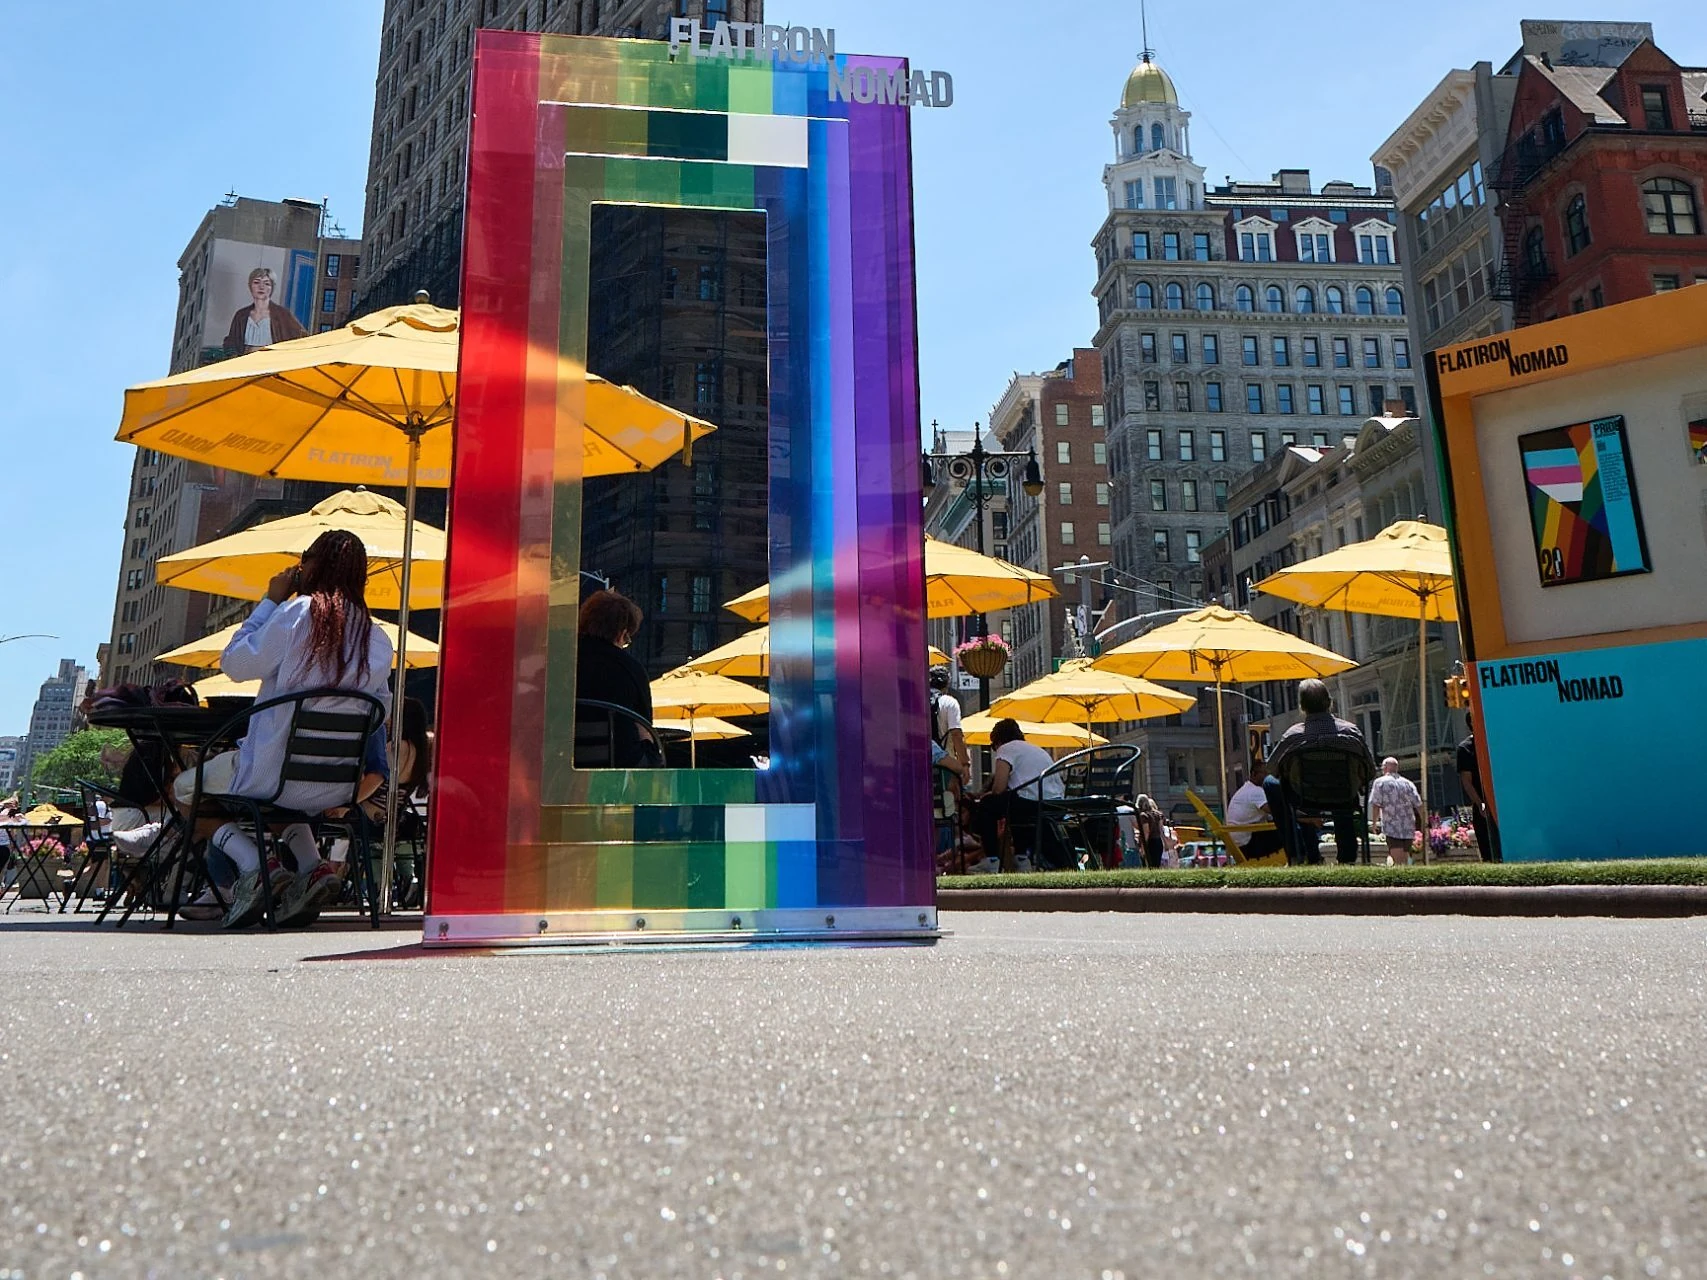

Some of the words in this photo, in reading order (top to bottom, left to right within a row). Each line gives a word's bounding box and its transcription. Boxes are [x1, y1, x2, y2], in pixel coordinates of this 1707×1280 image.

[668, 17, 836, 65] FLATIRON
[828, 64, 954, 108] NOMAD
[1438, 339, 1511, 374] FLATIRON
[1509, 345, 1569, 376] NOMAD
[307, 447, 393, 468] FLATIRON
[382, 465, 448, 480] NOAD
[1480, 659, 1560, 689] FLATIRON
[1557, 675, 1624, 703] NOMAD
